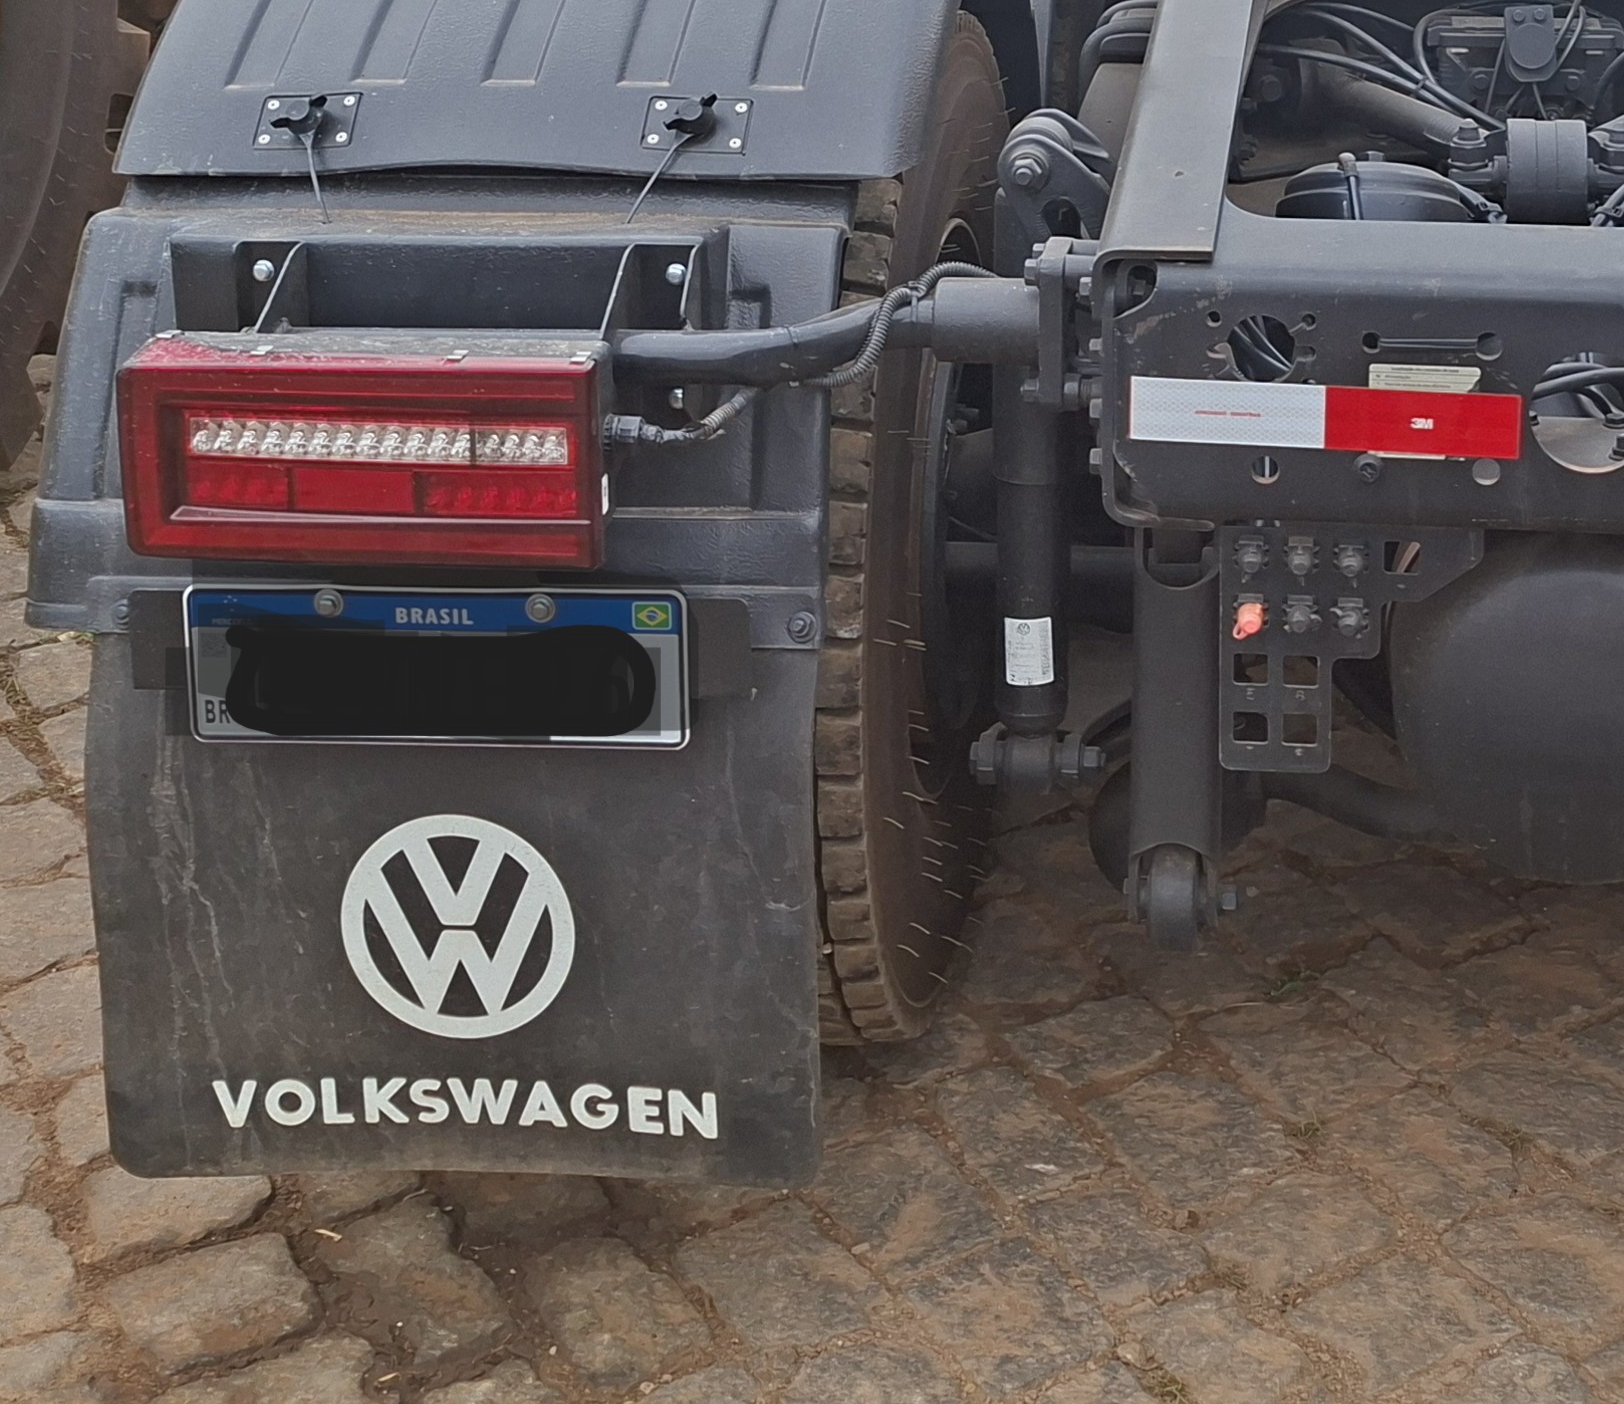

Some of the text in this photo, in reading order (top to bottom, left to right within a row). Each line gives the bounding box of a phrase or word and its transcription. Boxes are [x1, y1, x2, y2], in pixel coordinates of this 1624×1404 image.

[1410, 417, 1434, 429] 3M
[395, 607, 474, 625] BRASIL
[204, 699, 230, 724] BR
[341, 814, 575, 1039] VW
[212, 1078, 718, 1140] VOLKSWAGEN
